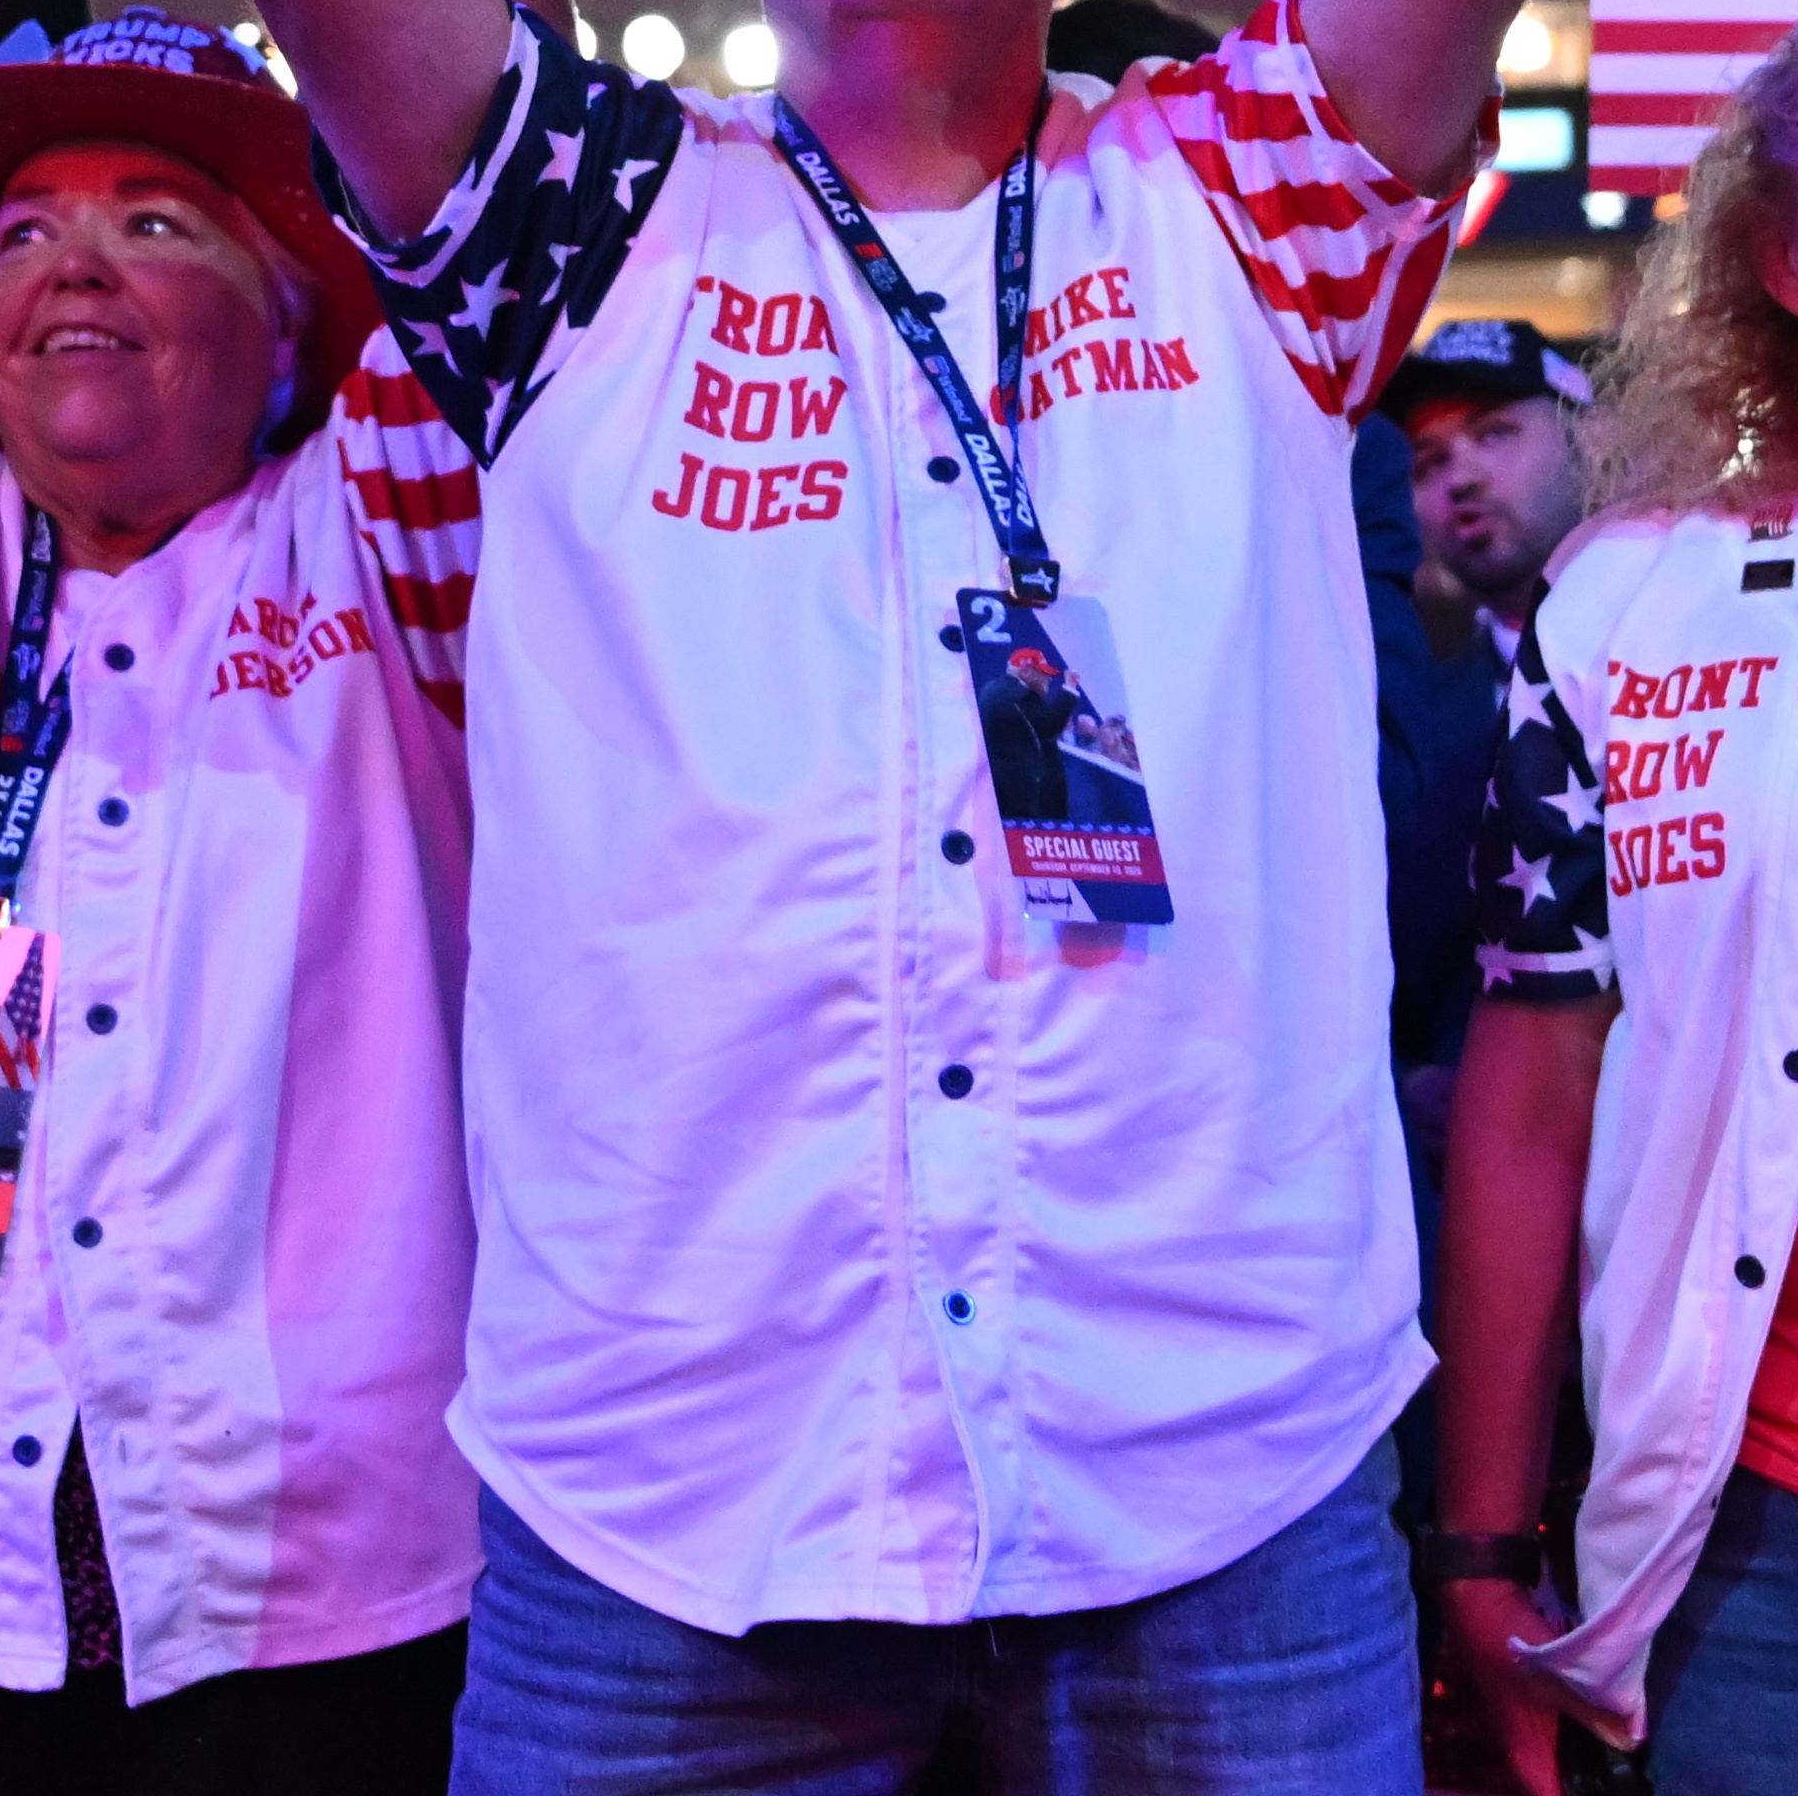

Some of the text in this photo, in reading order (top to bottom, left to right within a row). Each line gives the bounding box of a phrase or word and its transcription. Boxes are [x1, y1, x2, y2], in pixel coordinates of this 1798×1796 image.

[64, 19, 212, 54] TRUMP
[796, 150, 860, 227] DALLAS
[688, 275, 840, 358] RON
[1024, 266, 1137, 358] MIKE
[683, 360, 848, 443] ROW
[651, 452, 849, 533] JOES
[970, 595, 1012, 644] 2
[1606, 656, 1780, 720] RONT
[1605, 729, 1726, 806] ROW
[1023, 834, 1141, 863] SPECIAL GUEST
[1608, 812, 1726, 898] JOES
